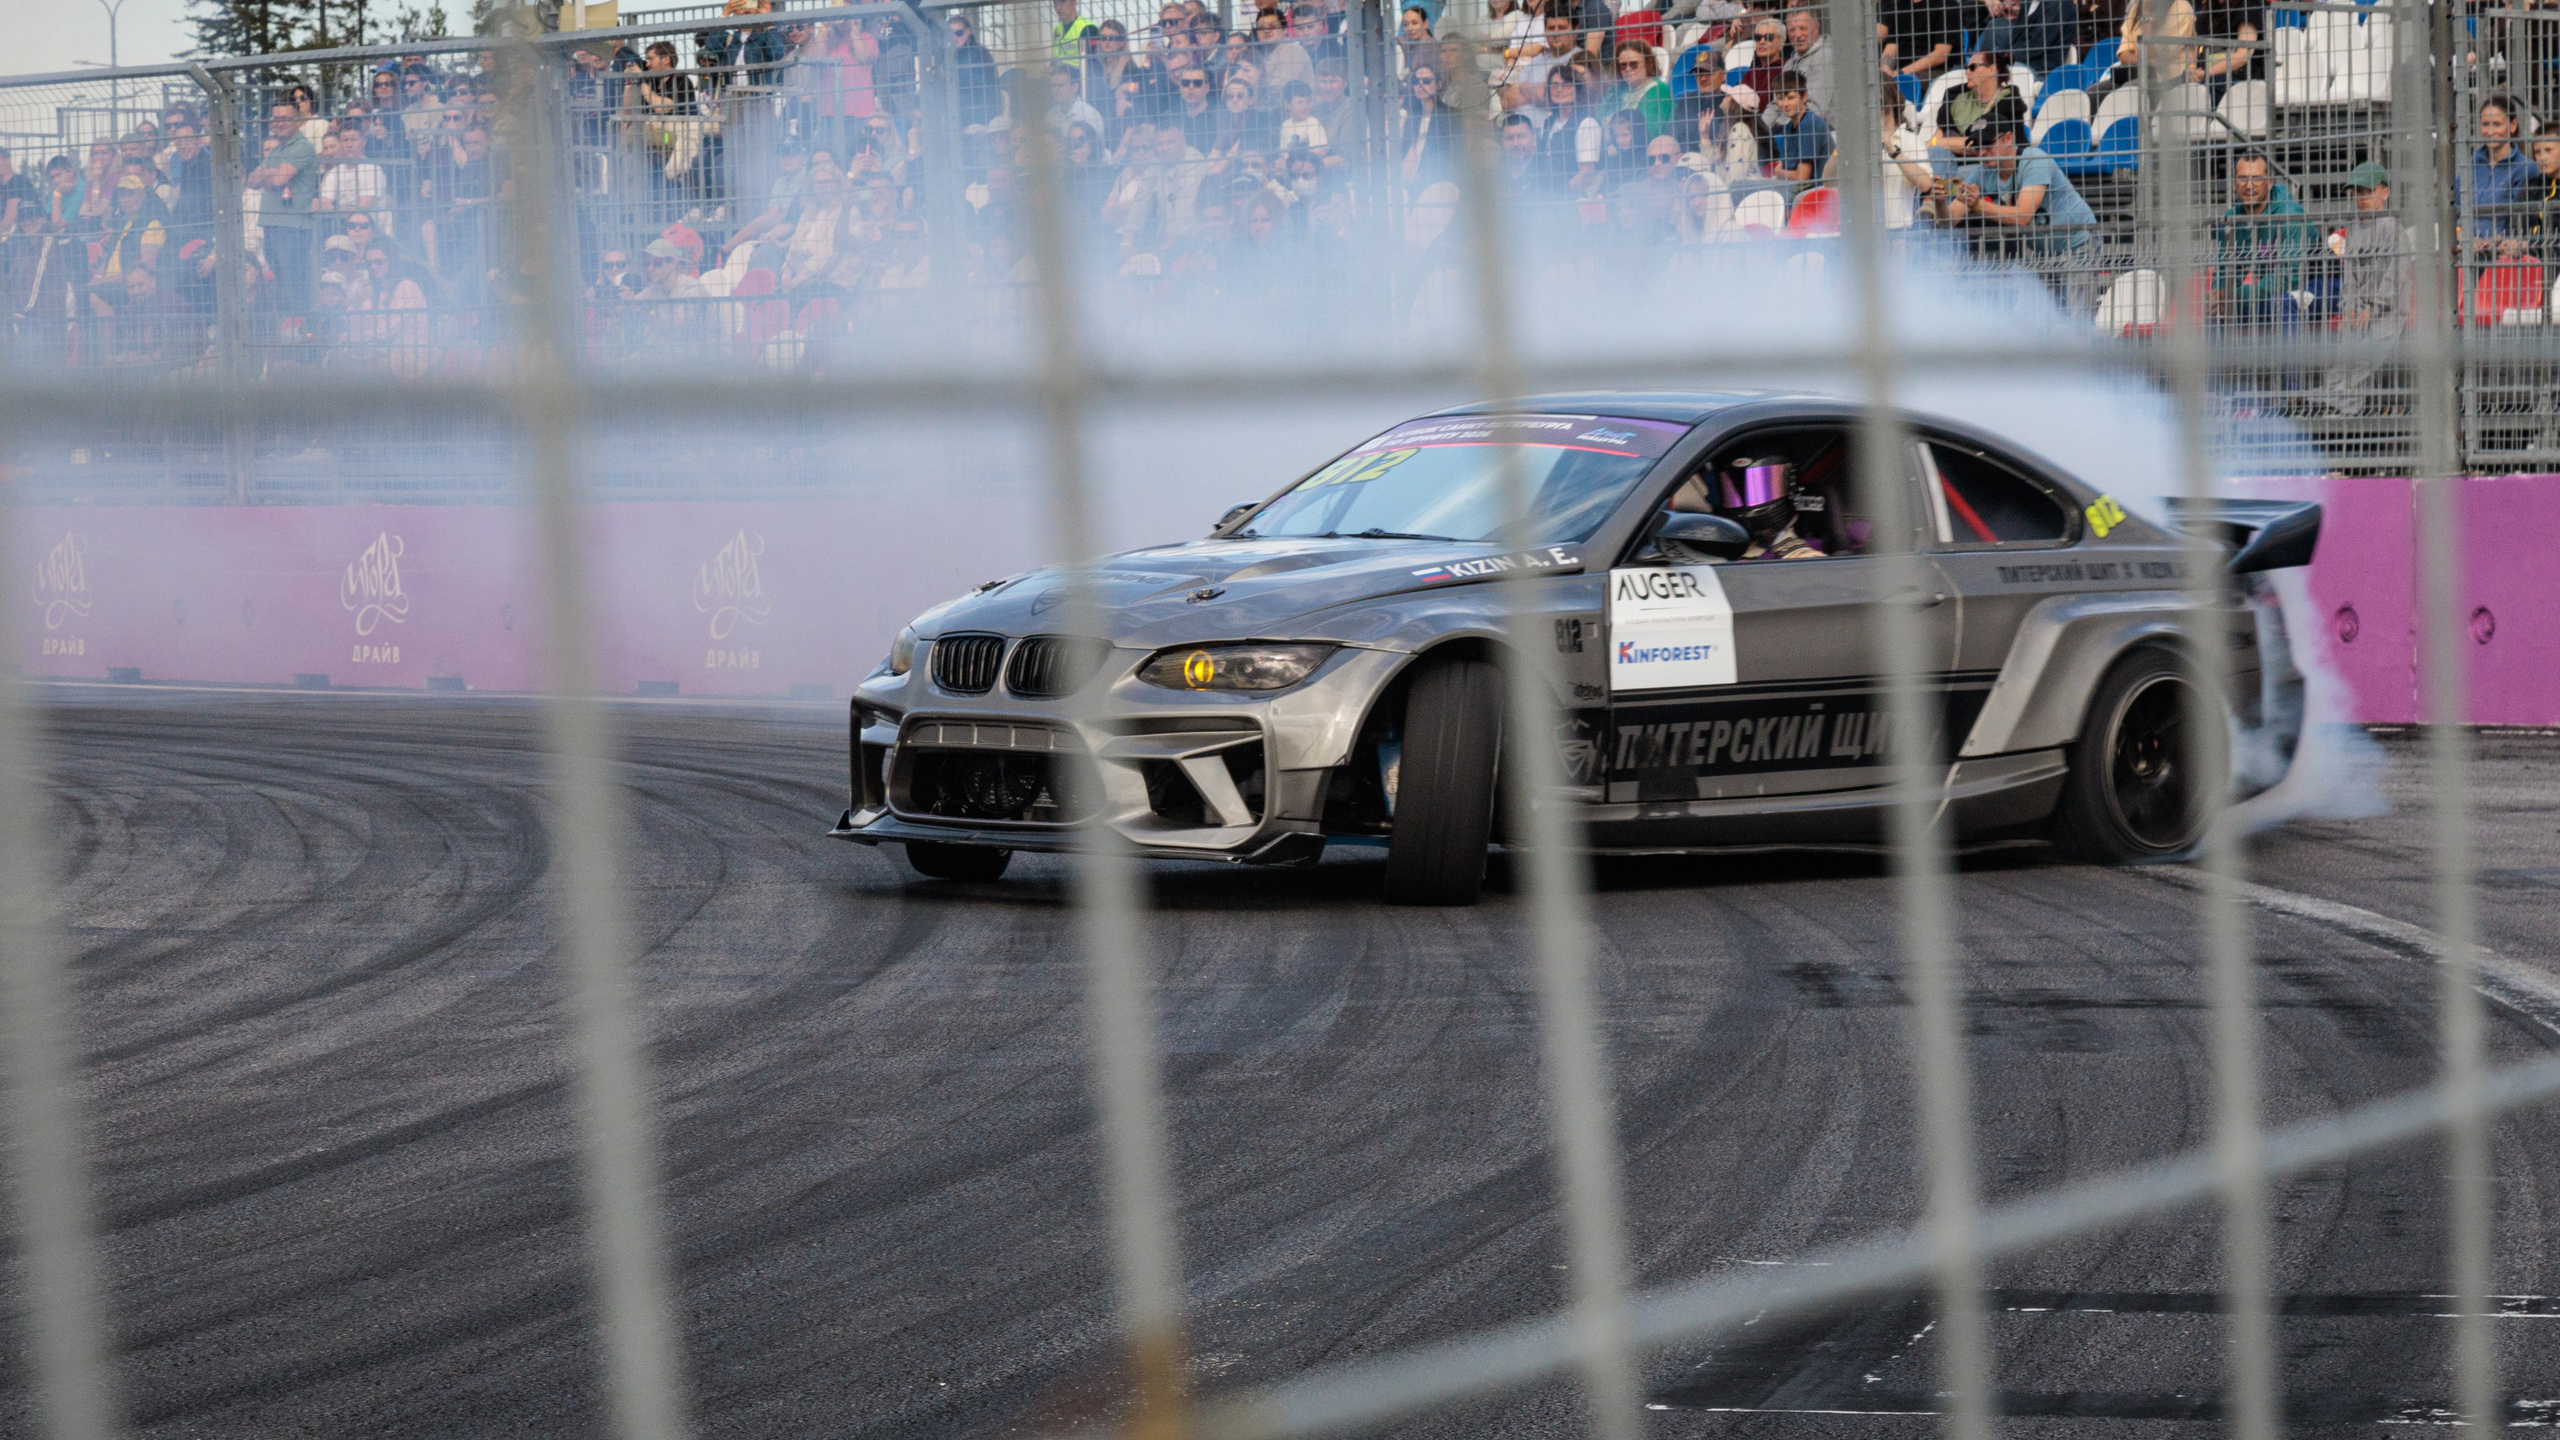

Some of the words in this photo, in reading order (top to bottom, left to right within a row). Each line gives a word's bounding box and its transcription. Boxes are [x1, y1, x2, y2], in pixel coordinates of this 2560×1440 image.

[1445, 555, 1517, 578] KIZIN
[1548, 547, 1579, 565] E.
[1617, 571, 1706, 601] AUGER
[41, 635, 85, 656] ДРАЙВ
[352, 641, 401, 664] ДРАЙВ
[705, 645, 760, 669] ДРАЙВ
[1617, 641, 1711, 665] KINFOREST
[1614, 703, 1825, 770] ПИТЕРСКИЙ
[1830, 711, 1903, 760] ЩИ
